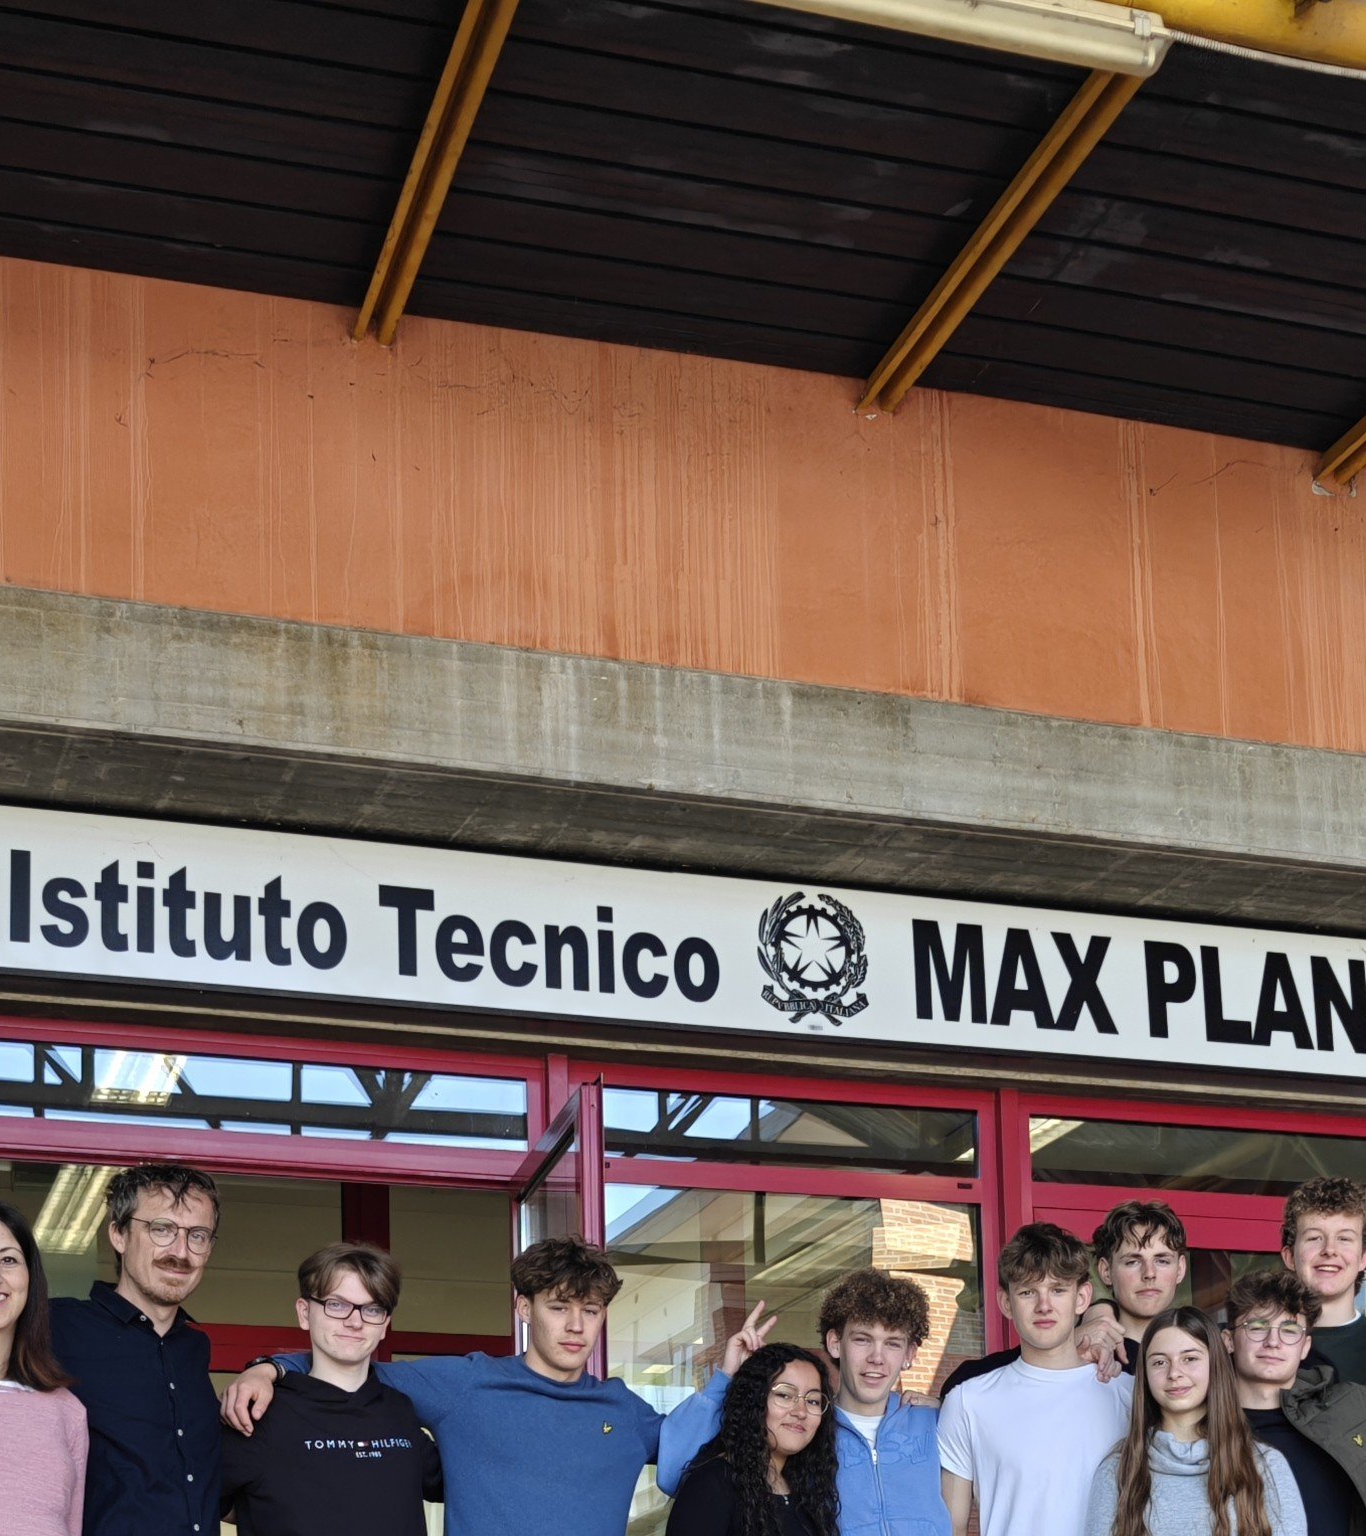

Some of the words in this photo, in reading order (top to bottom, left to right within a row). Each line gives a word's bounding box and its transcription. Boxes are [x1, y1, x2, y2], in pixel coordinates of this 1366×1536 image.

[10, 849, 347, 970] Istituto
[379, 884, 720, 1003] Tecnico
[911, 919, 1119, 1035] MAX
[304, 1440, 354, 1450] TOMMY
